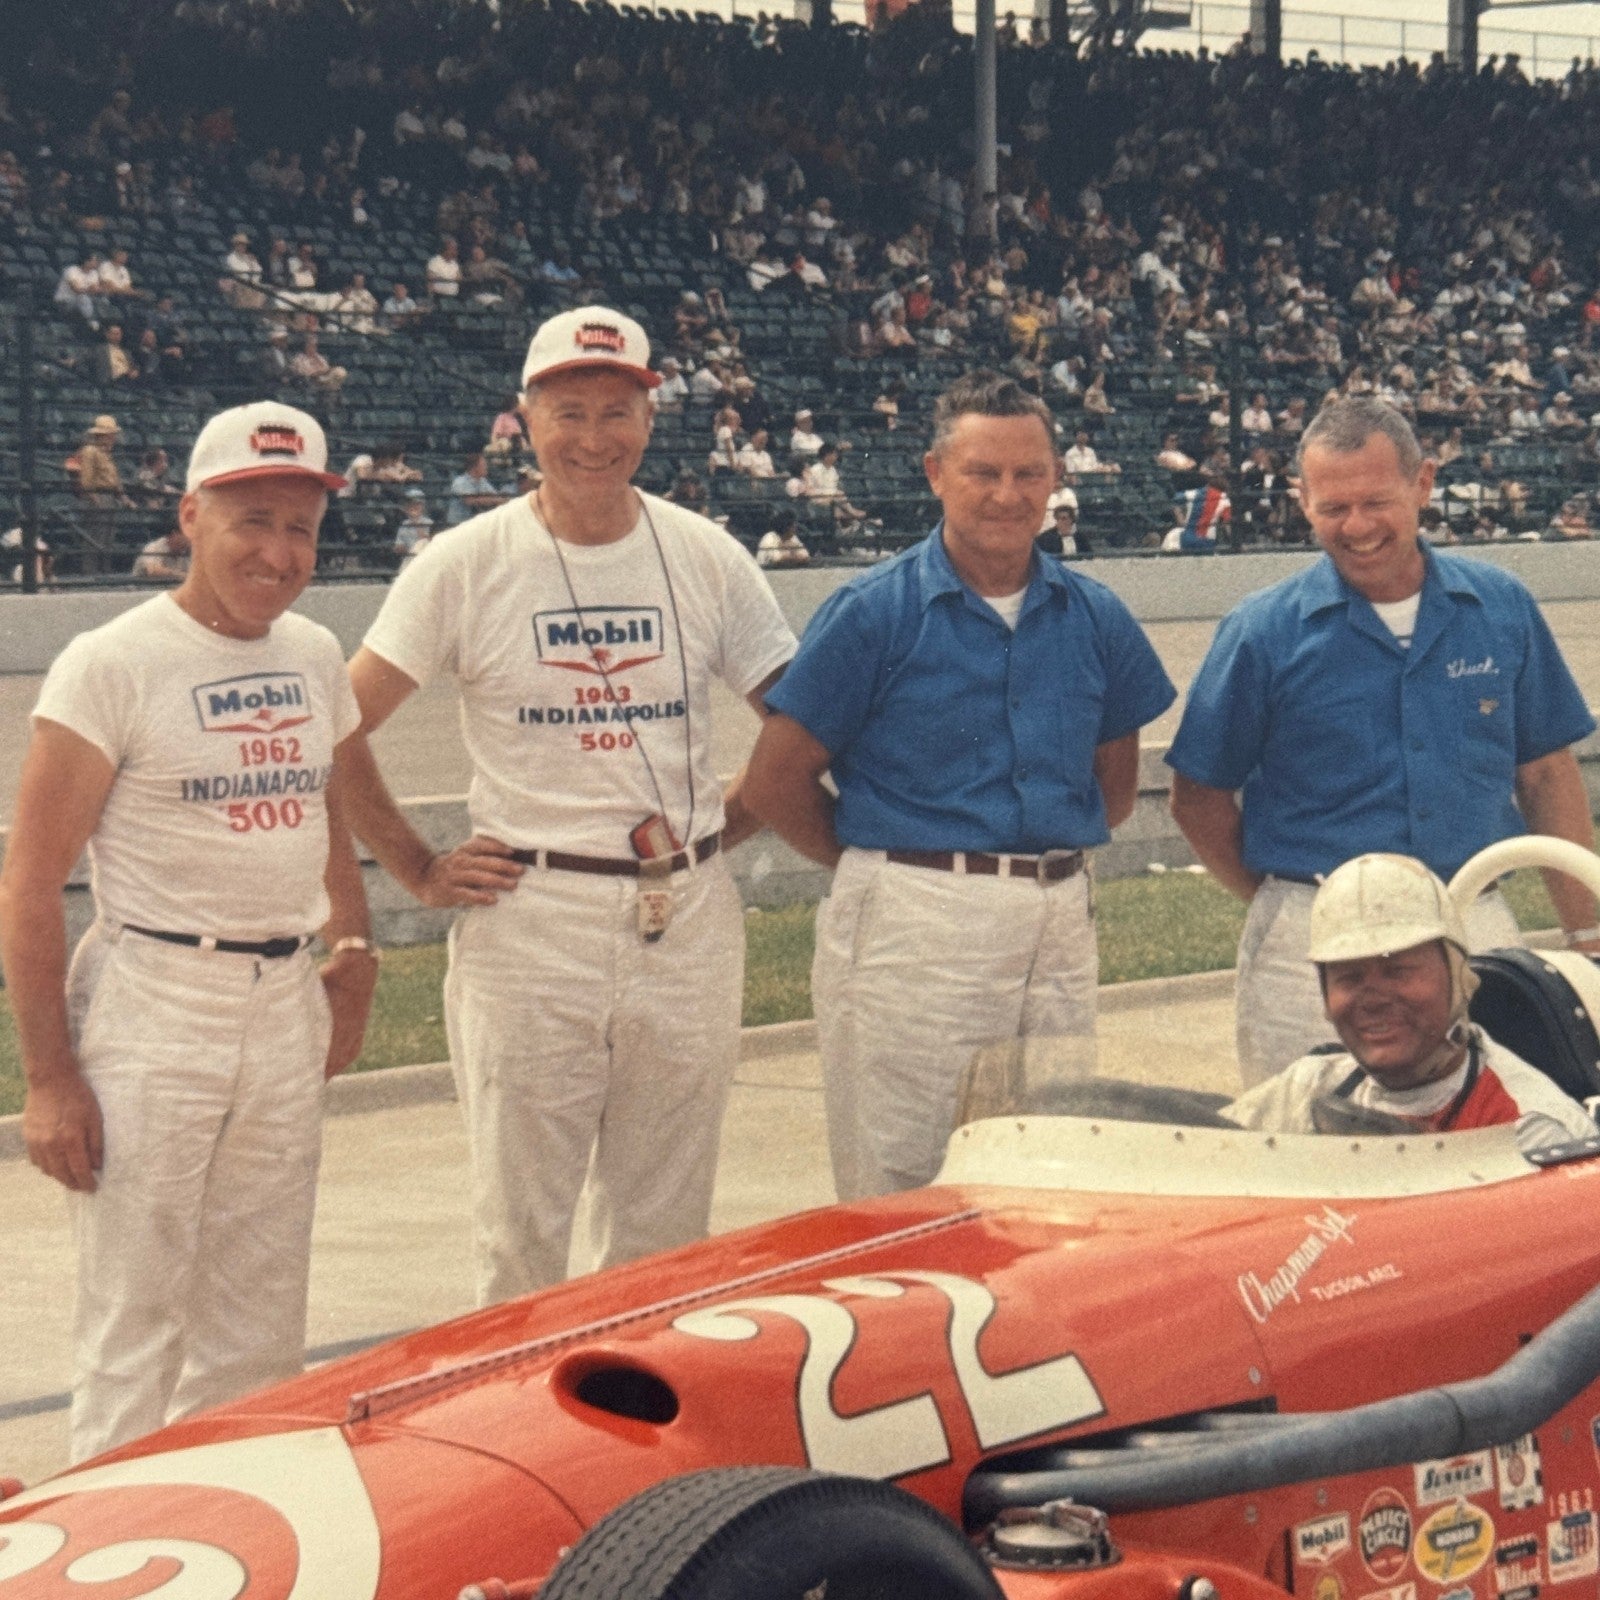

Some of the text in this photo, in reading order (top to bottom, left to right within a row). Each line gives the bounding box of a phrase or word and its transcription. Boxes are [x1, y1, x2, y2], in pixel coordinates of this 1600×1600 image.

[547, 618, 652, 646] Mobil
[208, 683, 302, 716] Mobil
[575, 685, 631, 705] 1963
[518, 700, 685, 724] INDIANAPOLIS
[239, 736, 303, 767] 1962
[672, 1269, 1108, 1480] 22
[1301, 1522, 1346, 1552] Mobil
